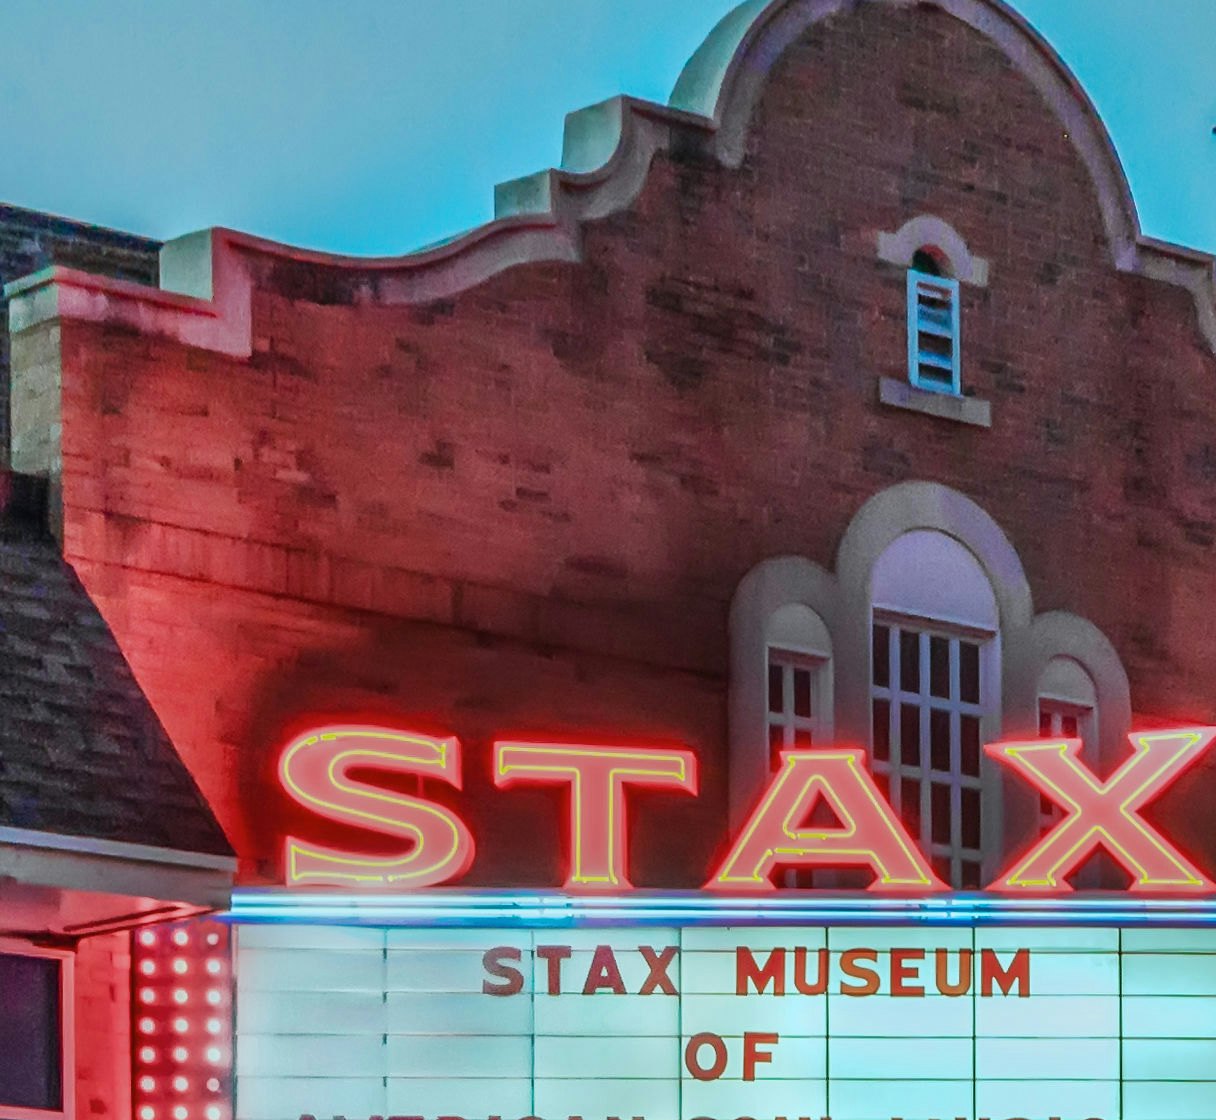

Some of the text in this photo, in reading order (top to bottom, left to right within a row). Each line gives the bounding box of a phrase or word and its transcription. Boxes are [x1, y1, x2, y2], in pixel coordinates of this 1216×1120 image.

[481, 945, 1031, 998] STAX MUSEUM
[684, 1030, 780, 1083] OF
